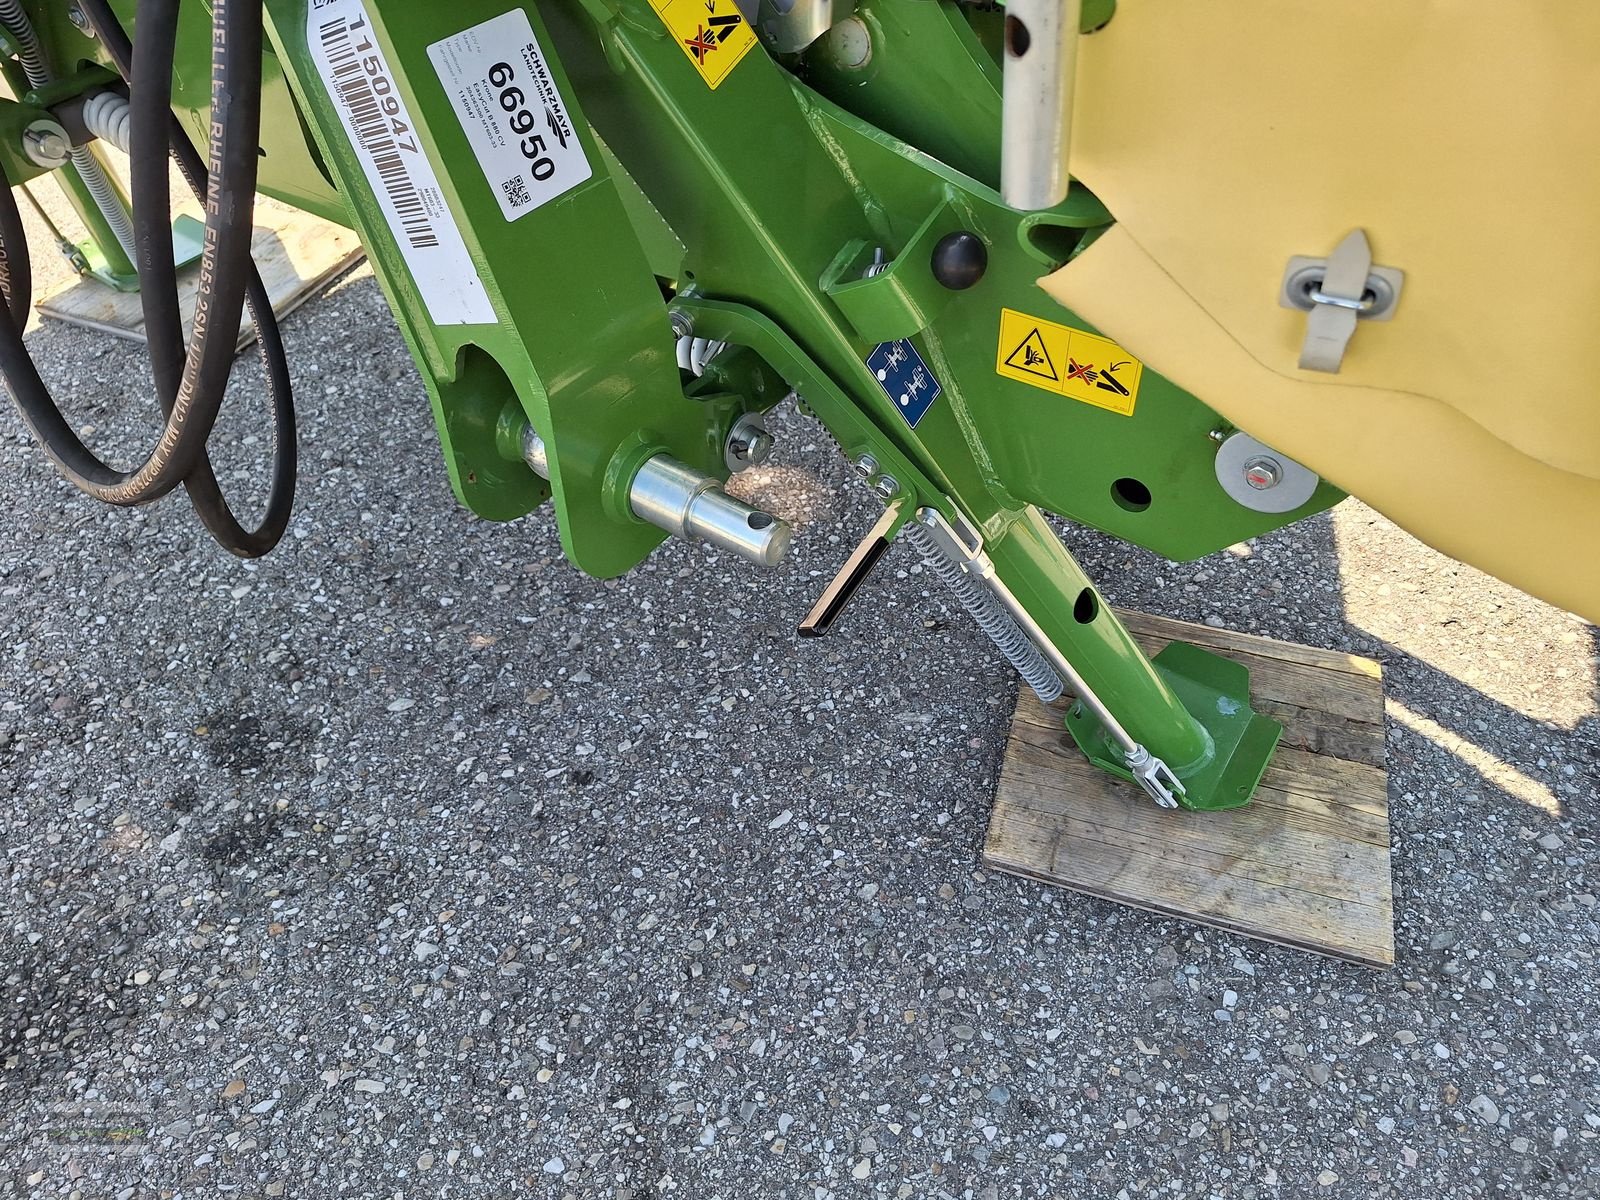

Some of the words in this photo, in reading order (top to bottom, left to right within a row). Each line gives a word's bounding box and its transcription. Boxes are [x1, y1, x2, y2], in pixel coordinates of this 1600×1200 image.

[347, 12, 419, 153] 1150947
[479, 77, 495, 102] Krone
[519, 47, 548, 105] LANDTECHNIK
[524, 42, 572, 138] SCHWARZMAYR
[329, 73, 367, 151] 1150947-0000000
[456, 89, 476, 120] 1150947
[471, 81, 491, 112] EasyCut
[486, 113, 494, 122] B
[488, 62, 555, 182] 66950
[489, 120, 501, 135] 880
[495, 134, 506, 147] CV
[207, 122, 224, 216] RHEINE
[200, 228, 218, 296] EN853
[191, 295, 208, 339] 2SN
[259, 348, 269, 369] MAX
[175, 380, 192, 423] DN12
[159, 422, 179, 457] MAX
[135, 469, 152, 489] 275
[147, 455, 164, 476] WP
[119, 480, 140, 499] BAR
